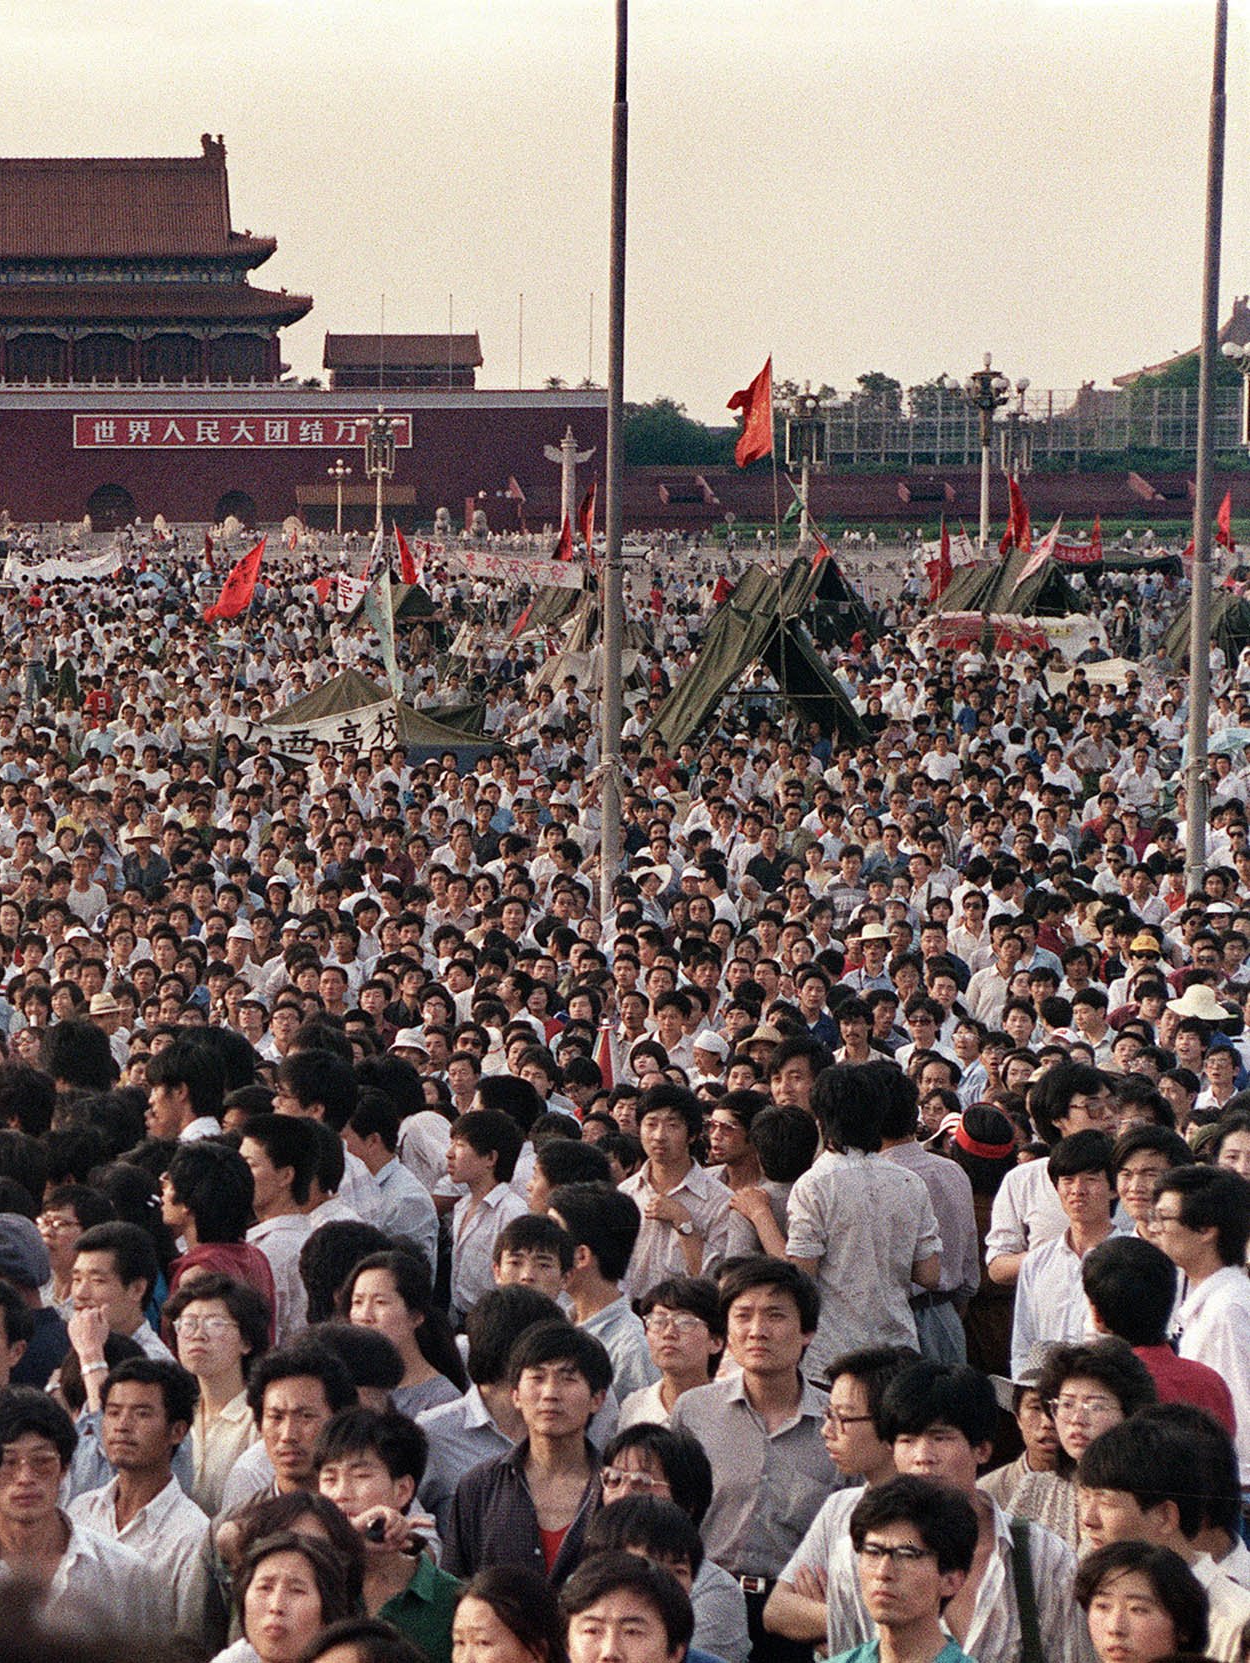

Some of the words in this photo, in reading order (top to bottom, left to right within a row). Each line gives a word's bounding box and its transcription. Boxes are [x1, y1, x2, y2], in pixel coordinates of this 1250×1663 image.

[92, 419, 390, 443] 世界人民大团结万
[97, 696, 107, 711] 9
